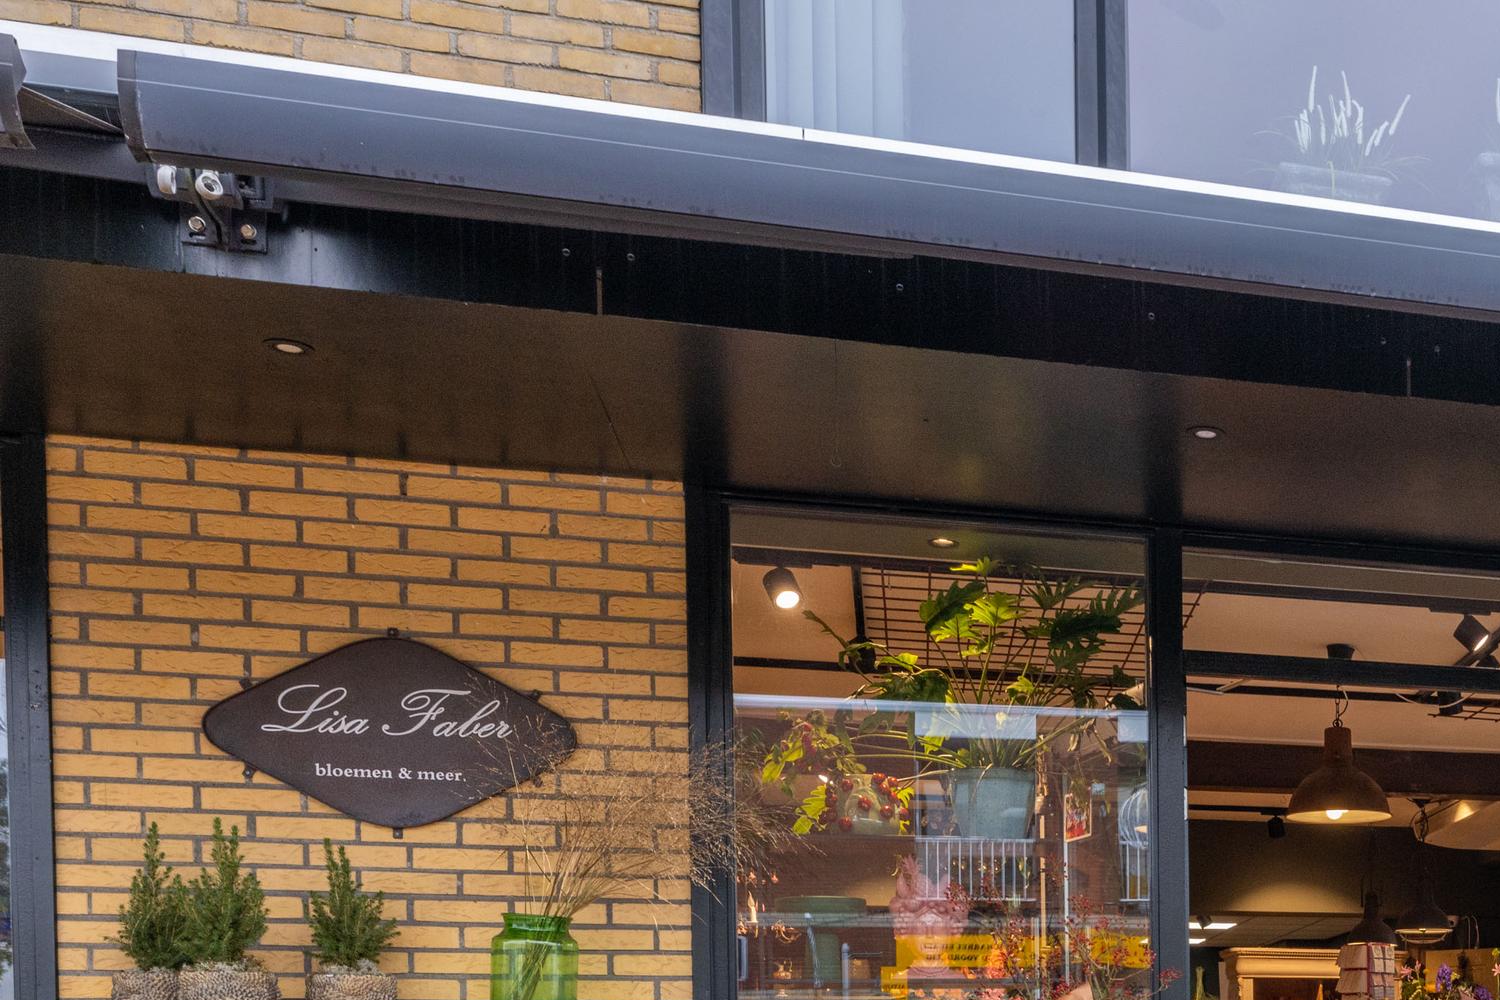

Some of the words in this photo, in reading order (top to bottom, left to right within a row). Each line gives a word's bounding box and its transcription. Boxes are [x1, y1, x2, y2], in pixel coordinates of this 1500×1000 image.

[260, 683, 370, 735] Lisa
[381, 688, 514, 739] Faber
[315, 763, 393, 779] bloemen
[398, 767, 412, 779] &
